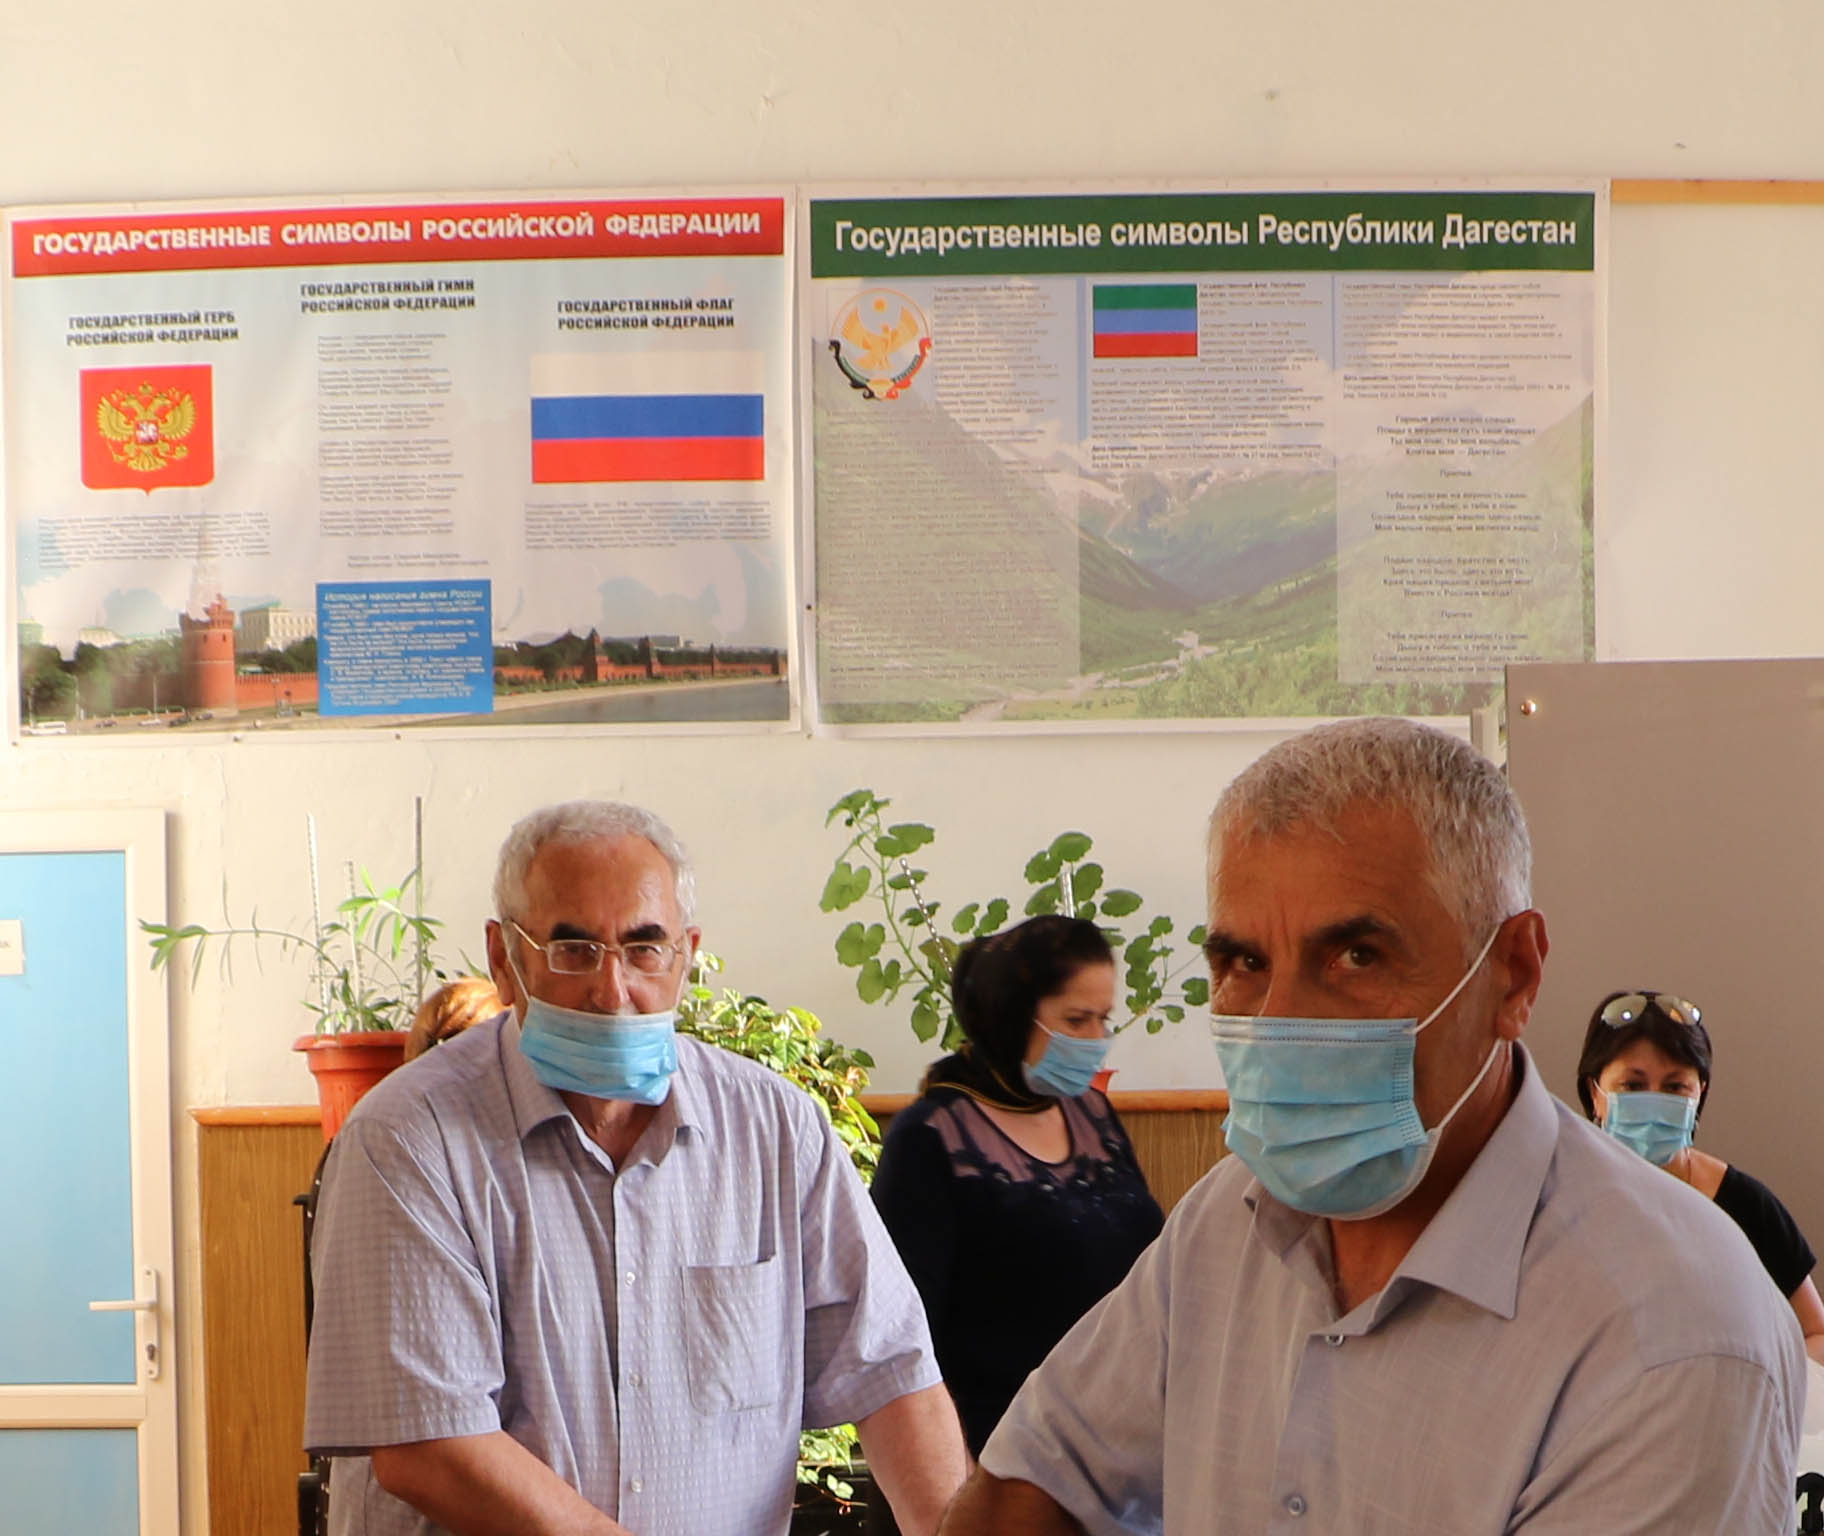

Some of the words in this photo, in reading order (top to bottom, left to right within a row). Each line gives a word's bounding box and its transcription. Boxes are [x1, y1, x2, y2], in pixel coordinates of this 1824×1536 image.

[32, 224, 271, 255] ГОСУДАРСТВЕННЫЕ
[280, 220, 412, 247] СИМВОЛЫ
[422, 209, 595, 241] РОССИЙСКОЙ
[605, 211, 762, 238] ФЕДЕРАЦИИ
[835, 220, 1102, 254] Государственные
[1110, 221, 1249, 248] символы
[1257, 214, 1435, 250] Республики
[1442, 215, 1578, 249] Дагестан
[300, 278, 434, 296] ГОСУДАРСТВЕННЫЙ
[438, 279, 474, 292] ГИМН
[301, 297, 389, 313] РОССИЙСКОЙ
[393, 296, 475, 310] ФЕДЕРАЦИИ
[557, 297, 692, 313] ГОСУДАРСТВЕННЫЙ
[696, 298, 734, 311] ФЛАГ
[69, 311, 201, 329] ГОСУДАРСТВЕННЫЙ
[204, 311, 235, 324] ГЕРБ
[558, 314, 648, 329] РОССИЙСКОЙ
[652, 314, 734, 329] ФЕДЕРАЦИИ
[66, 329, 154, 346] РОССИЙСКОЙ
[157, 328, 239, 342] ФЕДЕРАЦИИ
